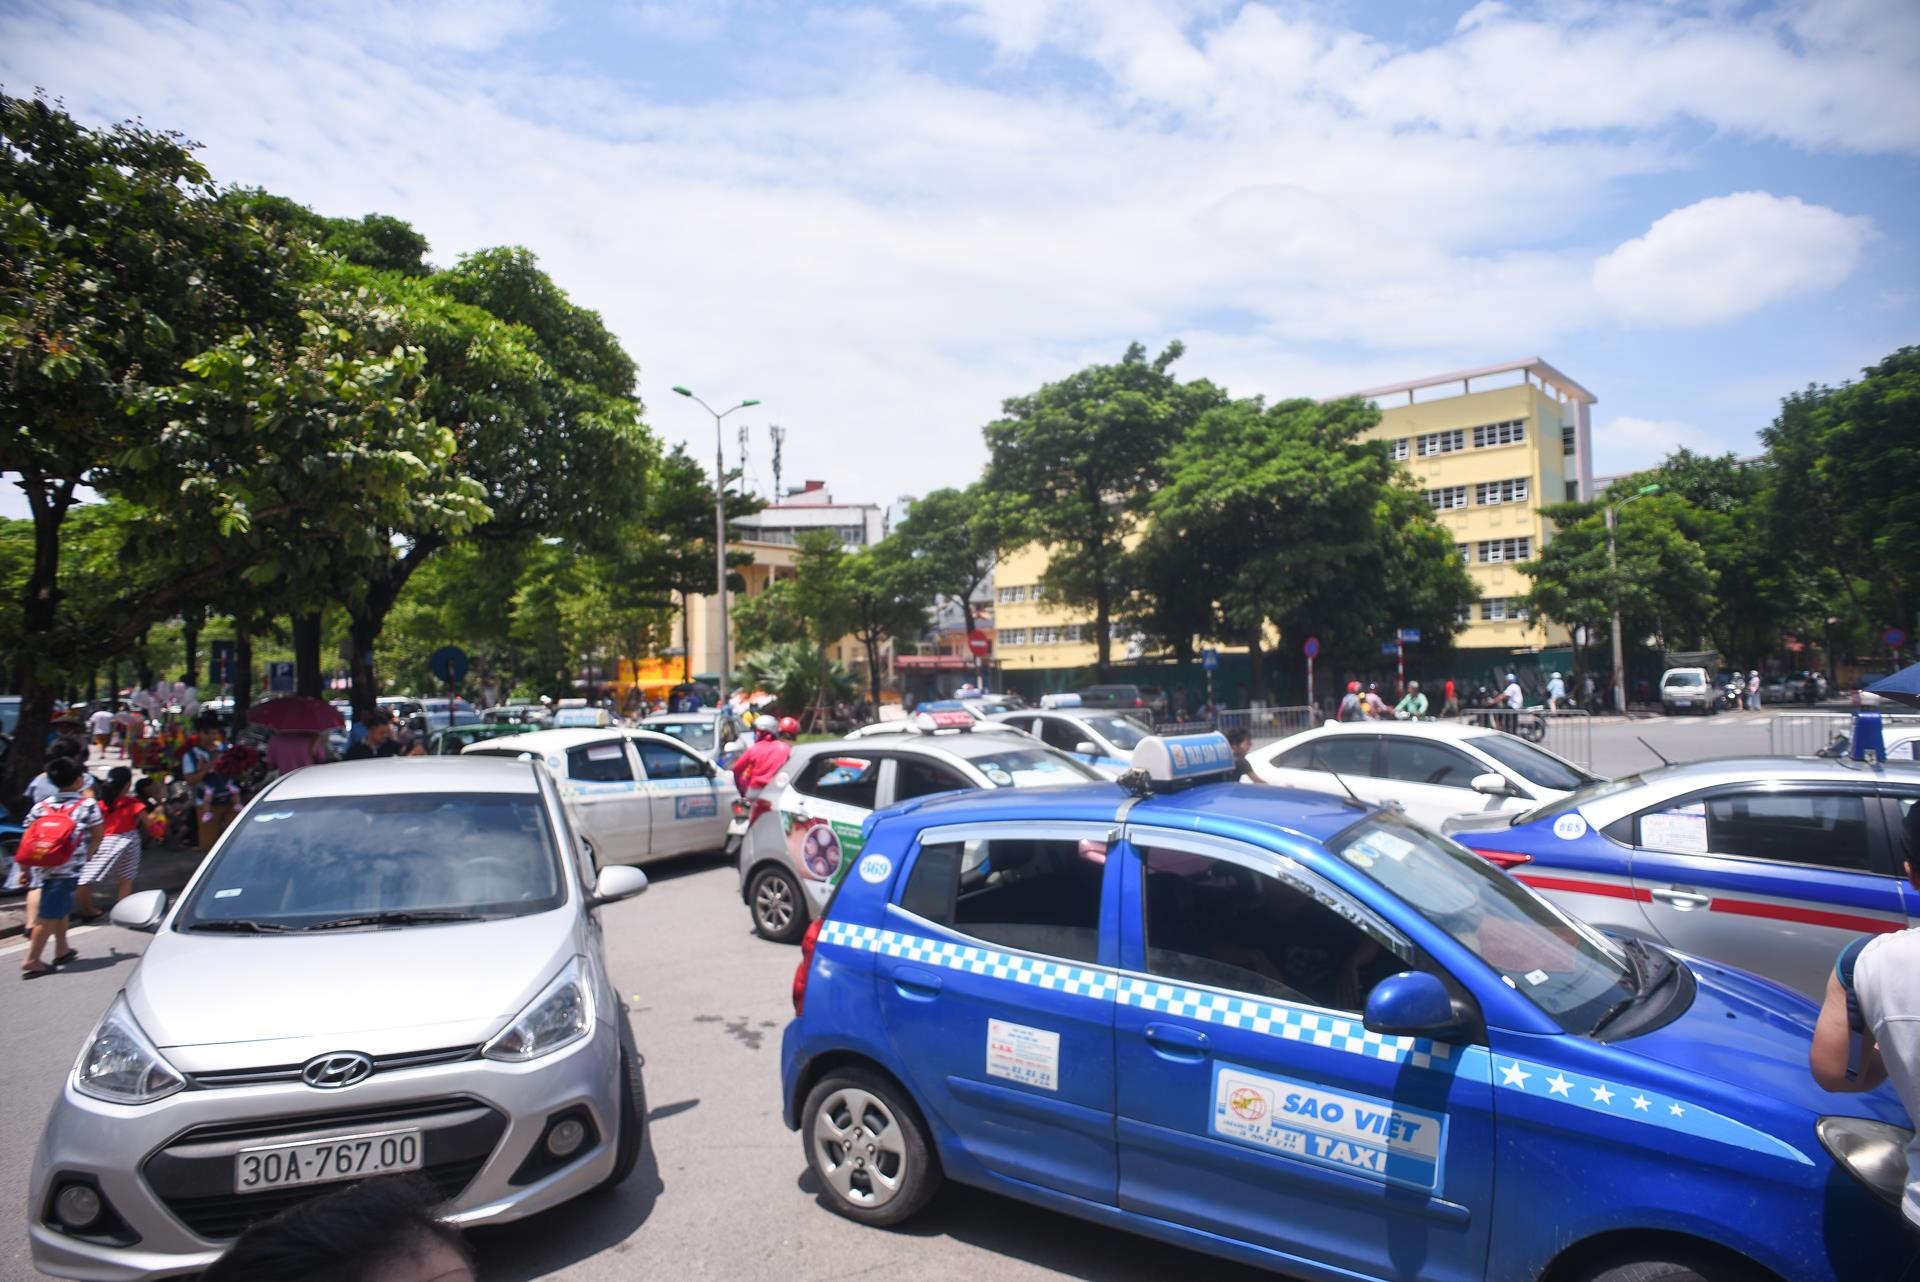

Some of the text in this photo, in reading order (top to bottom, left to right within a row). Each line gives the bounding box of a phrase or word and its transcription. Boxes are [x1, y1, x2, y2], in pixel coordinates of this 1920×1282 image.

[276, 663, 289, 676] P
[861, 860, 888, 876] 369
[1282, 1093, 1422, 1143] SAO VIỆT
[242, 1136, 417, 1186] 30A-767.00
[1314, 1136, 1387, 1172] TAXI
